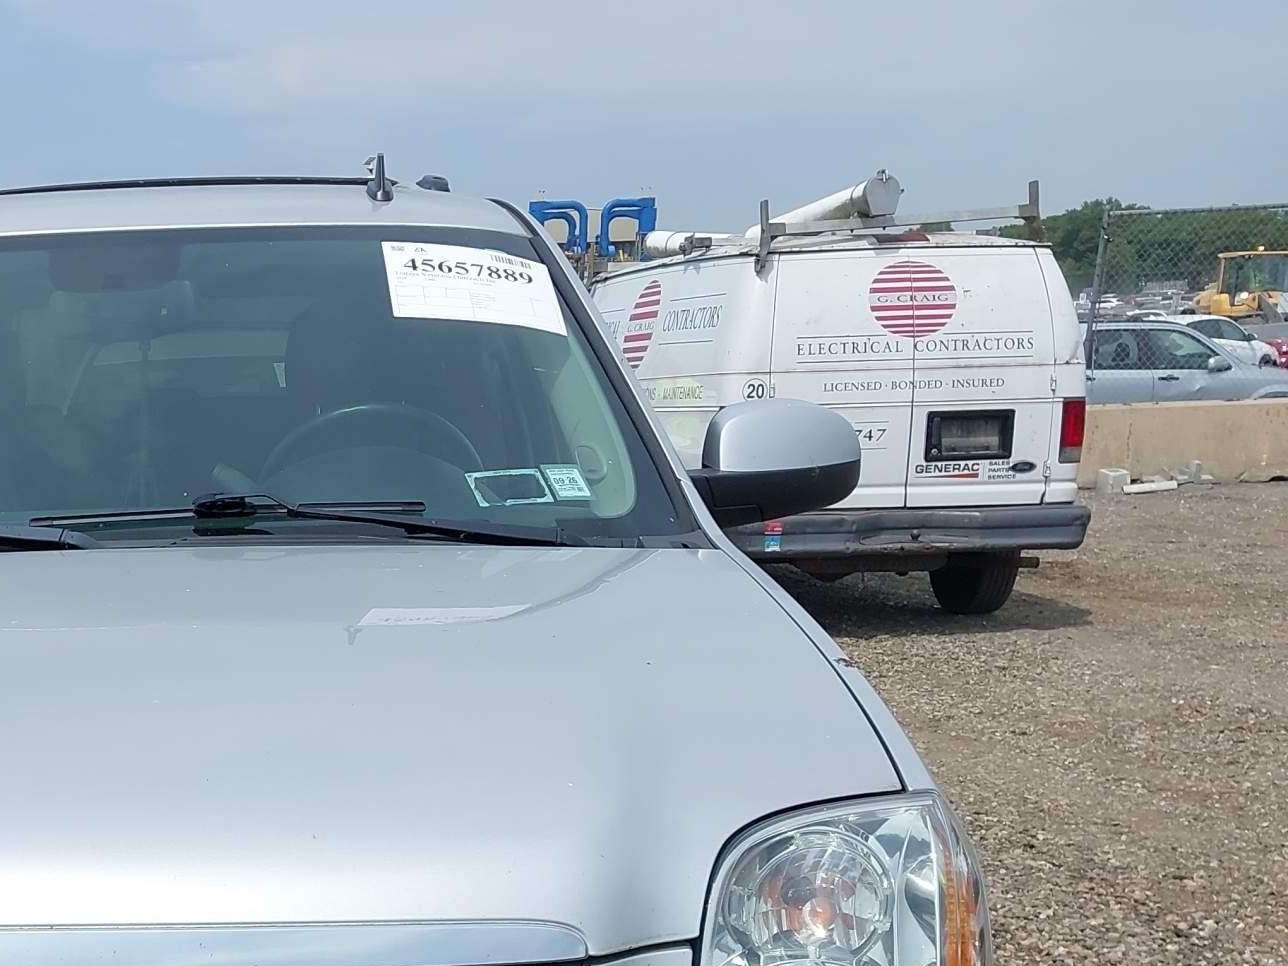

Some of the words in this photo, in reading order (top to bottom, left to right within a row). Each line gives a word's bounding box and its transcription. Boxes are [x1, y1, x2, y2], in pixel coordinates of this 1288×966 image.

[403, 257, 534, 285] 45657889
[897, 294, 949, 303] CRAIG
[662, 305, 723, 332] CONTRACTORS
[797, 340, 904, 356] ELECTRICAL
[913, 336, 1035, 353] CONTRACTORS
[662, 385, 704, 400] MAINTENANCE
[746, 383, 765, 399] 20
[823, 381, 883, 393] LICENSED
[890, 379, 943, 391] BONDED
[951, 377, 1005, 389] INSURED
[914, 462, 980, 474] GENERAC
